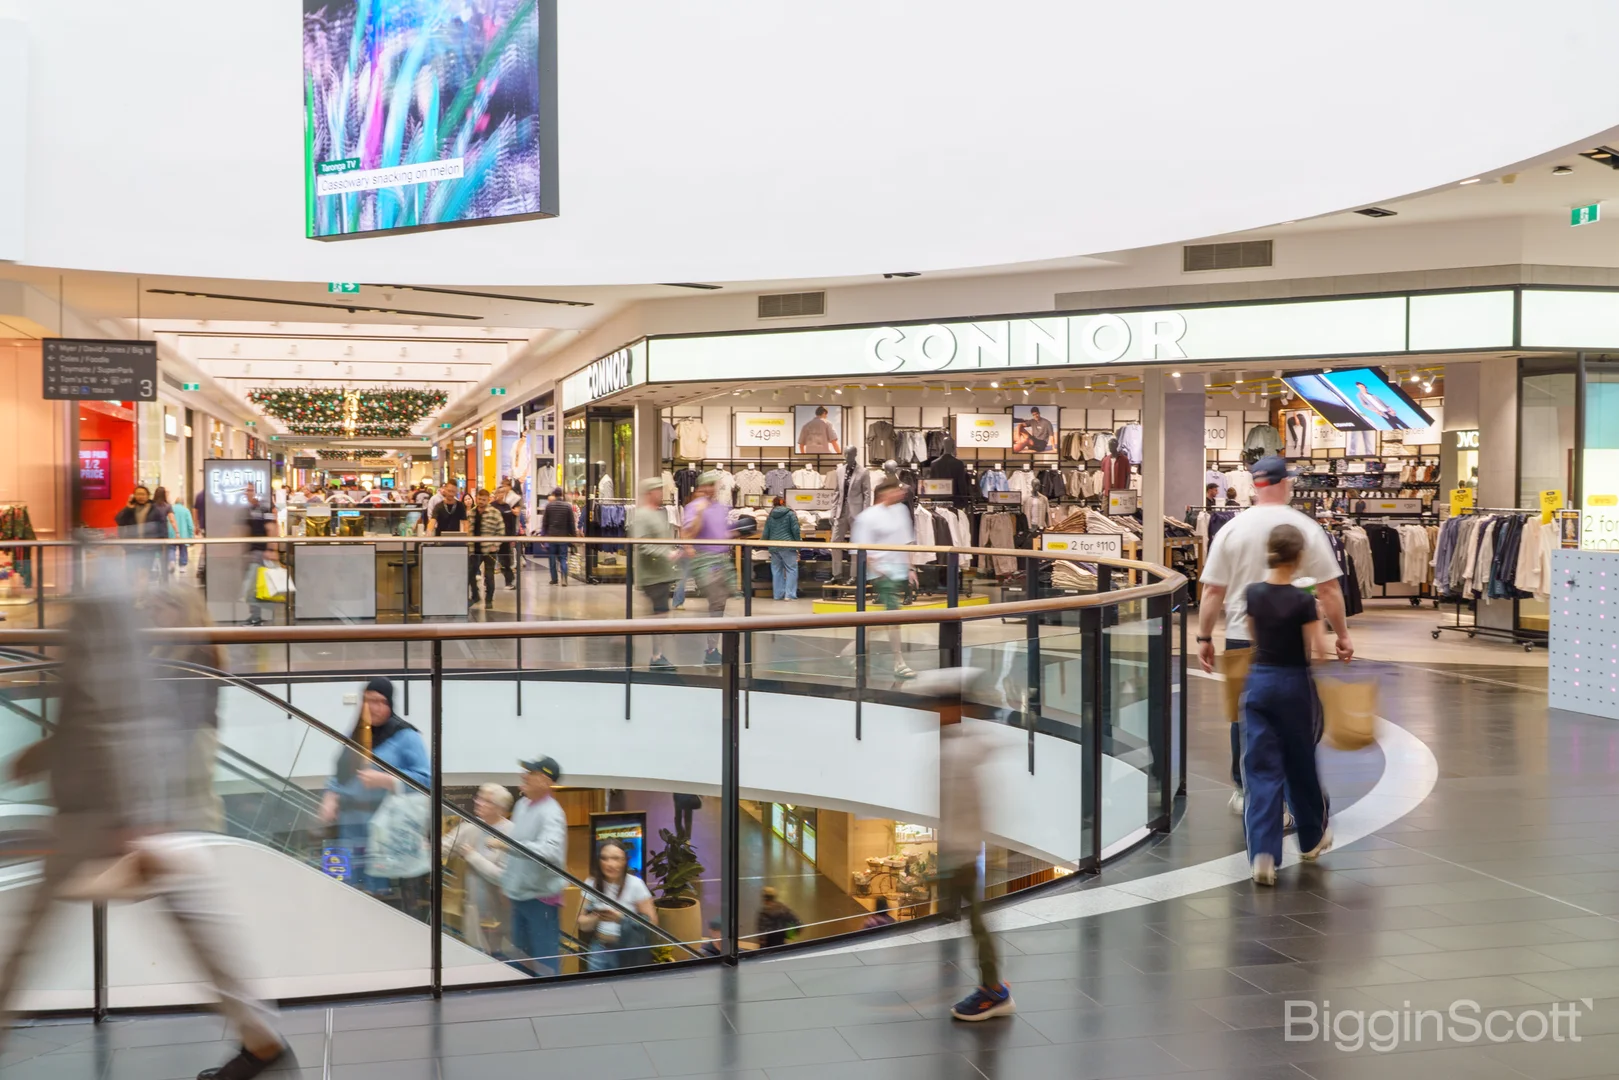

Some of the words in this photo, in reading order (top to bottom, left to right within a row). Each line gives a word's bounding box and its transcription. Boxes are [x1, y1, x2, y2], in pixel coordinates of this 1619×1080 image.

[346, 160, 357, 169] TV
[321, 176, 369, 191] Cassowary
[372, 171, 413, 185] snacking
[416, 169, 428, 179] on
[430, 163, 460, 177] melon
[59, 344, 78, 354] Myer
[83, 345, 104, 353] David
[104, 346, 126, 354] Jones
[864, 312, 1188, 373] CONNOR
[588, 348, 633, 399] CONNOR
[140, 379, 153, 397] 3
[84, 459, 100, 469] 1/2
[80, 469, 105, 479] PRICE
[1585, 515, 1593, 532] 2
[1071, 541, 1077, 551] 2
[1080, 540, 1094, 551] for
[1096, 541, 1116, 551] $110
